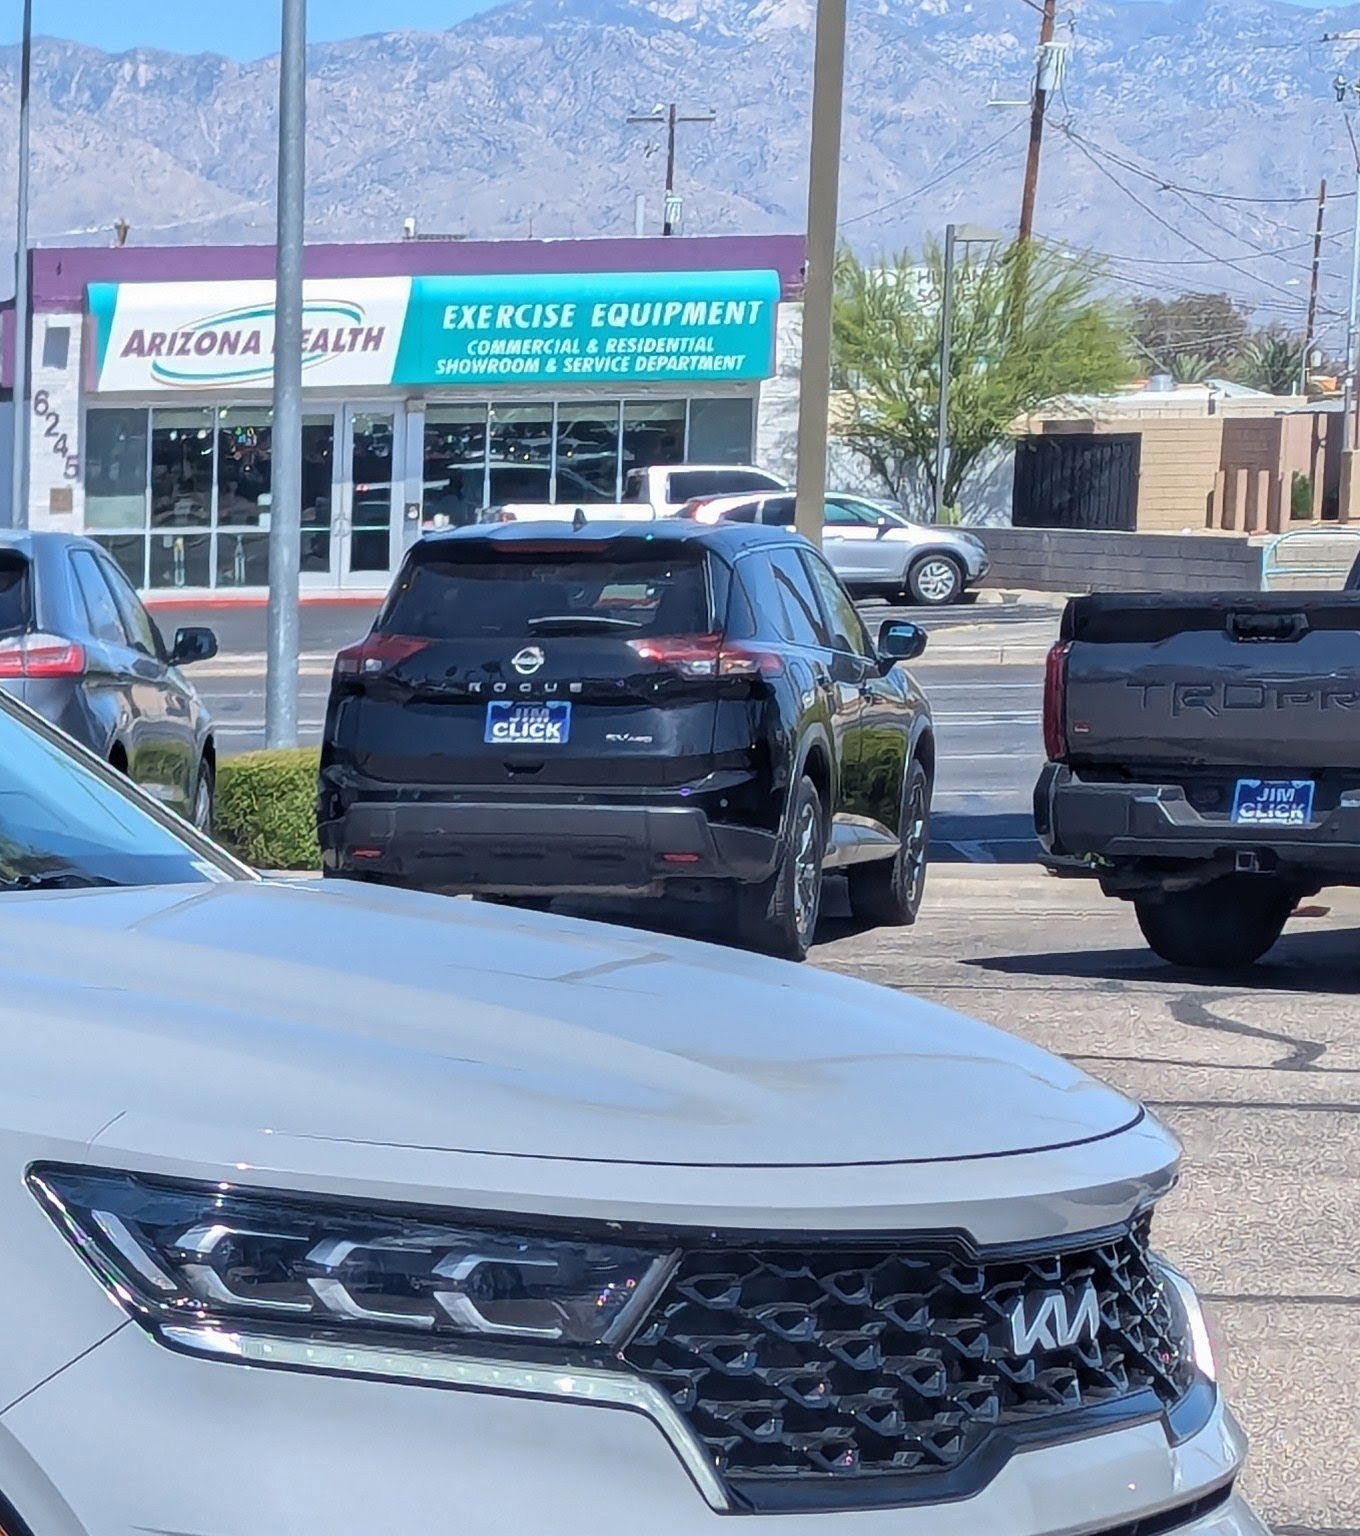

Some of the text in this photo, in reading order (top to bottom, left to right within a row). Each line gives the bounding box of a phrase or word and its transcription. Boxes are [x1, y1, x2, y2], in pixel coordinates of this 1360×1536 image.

[442, 300, 764, 330] EXERCISE EQUIPMENT
[120, 327, 385, 358] ARIZONA EALTH
[467, 336, 715, 356] COMMERCIAL & RESIDENTIAL
[435, 354, 747, 376] SHOWROOM & SERVICE DEPARTMENT
[33, 389, 80, 479] 6245
[492, 721, 562, 738] CLICK
[1255, 787, 1296, 802] JIM
[1238, 802, 1305, 818] CLICK
